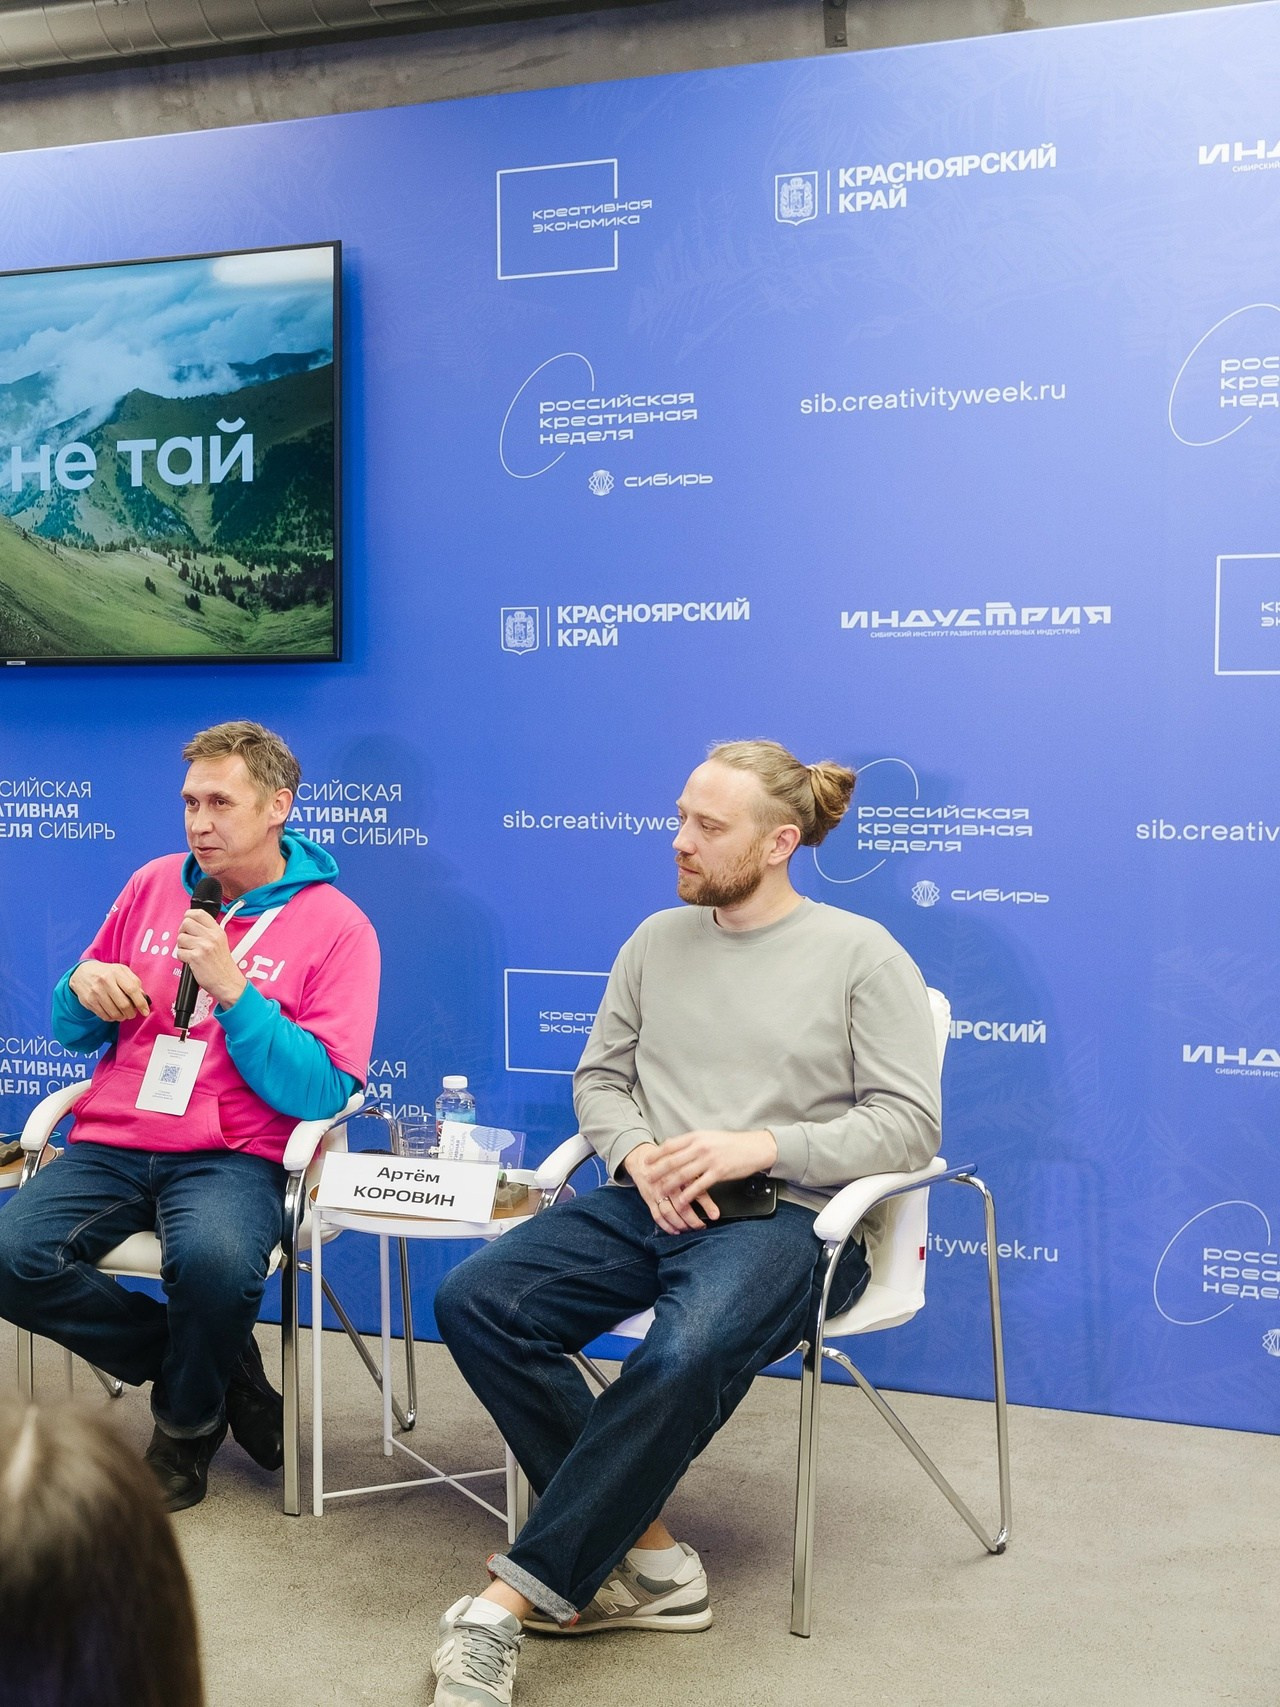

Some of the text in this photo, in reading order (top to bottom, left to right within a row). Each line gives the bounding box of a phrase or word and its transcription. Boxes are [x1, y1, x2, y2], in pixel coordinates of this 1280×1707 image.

[838, 142, 1057, 188] КРАСНОЯРСКИЙ
[532, 199, 652, 220] креативная
[838, 186, 908, 214] КРАЙ
[532, 214, 640, 234] экономика
[539, 392, 694, 415] российская
[800, 380, 1066, 414] sib.creativityweek.ru
[540, 409, 697, 429] креативная
[540, 428, 634, 445] неделя
[11, 440, 97, 492] не
[117, 417, 254, 487] тай
[624, 472, 713, 488] сибирь
[557, 597, 751, 624] КРАСНОЯРСКИЙ
[841, 601, 1112, 629] ИНДУСТРИЯ
[557, 624, 619, 647] КРАЙ
[296, 779, 402, 802] СИЙСКАЯ
[289, 806, 387, 824] АТИВНАЯ
[858, 804, 1029, 821] российская
[38, 820, 116, 841] СИБИРЬ
[503, 810, 680, 836] sib.creativitywe
[858, 821, 1033, 838] креативная
[341, 826, 429, 846] СИБИРЬ
[858, 837, 962, 854] неделя
[951, 886, 1050, 904] сибирь
[539, 1010, 597, 1022] креат
[539, 1023, 593, 1035] эконо
[377, 1165, 441, 1185] Артём
[353, 1186, 456, 1208] КОРОВИН
[1203, 1247, 1278, 1265] росс
[1203, 1264, 1280, 1283] креа
[1203, 1281, 1280, 1300] неде
